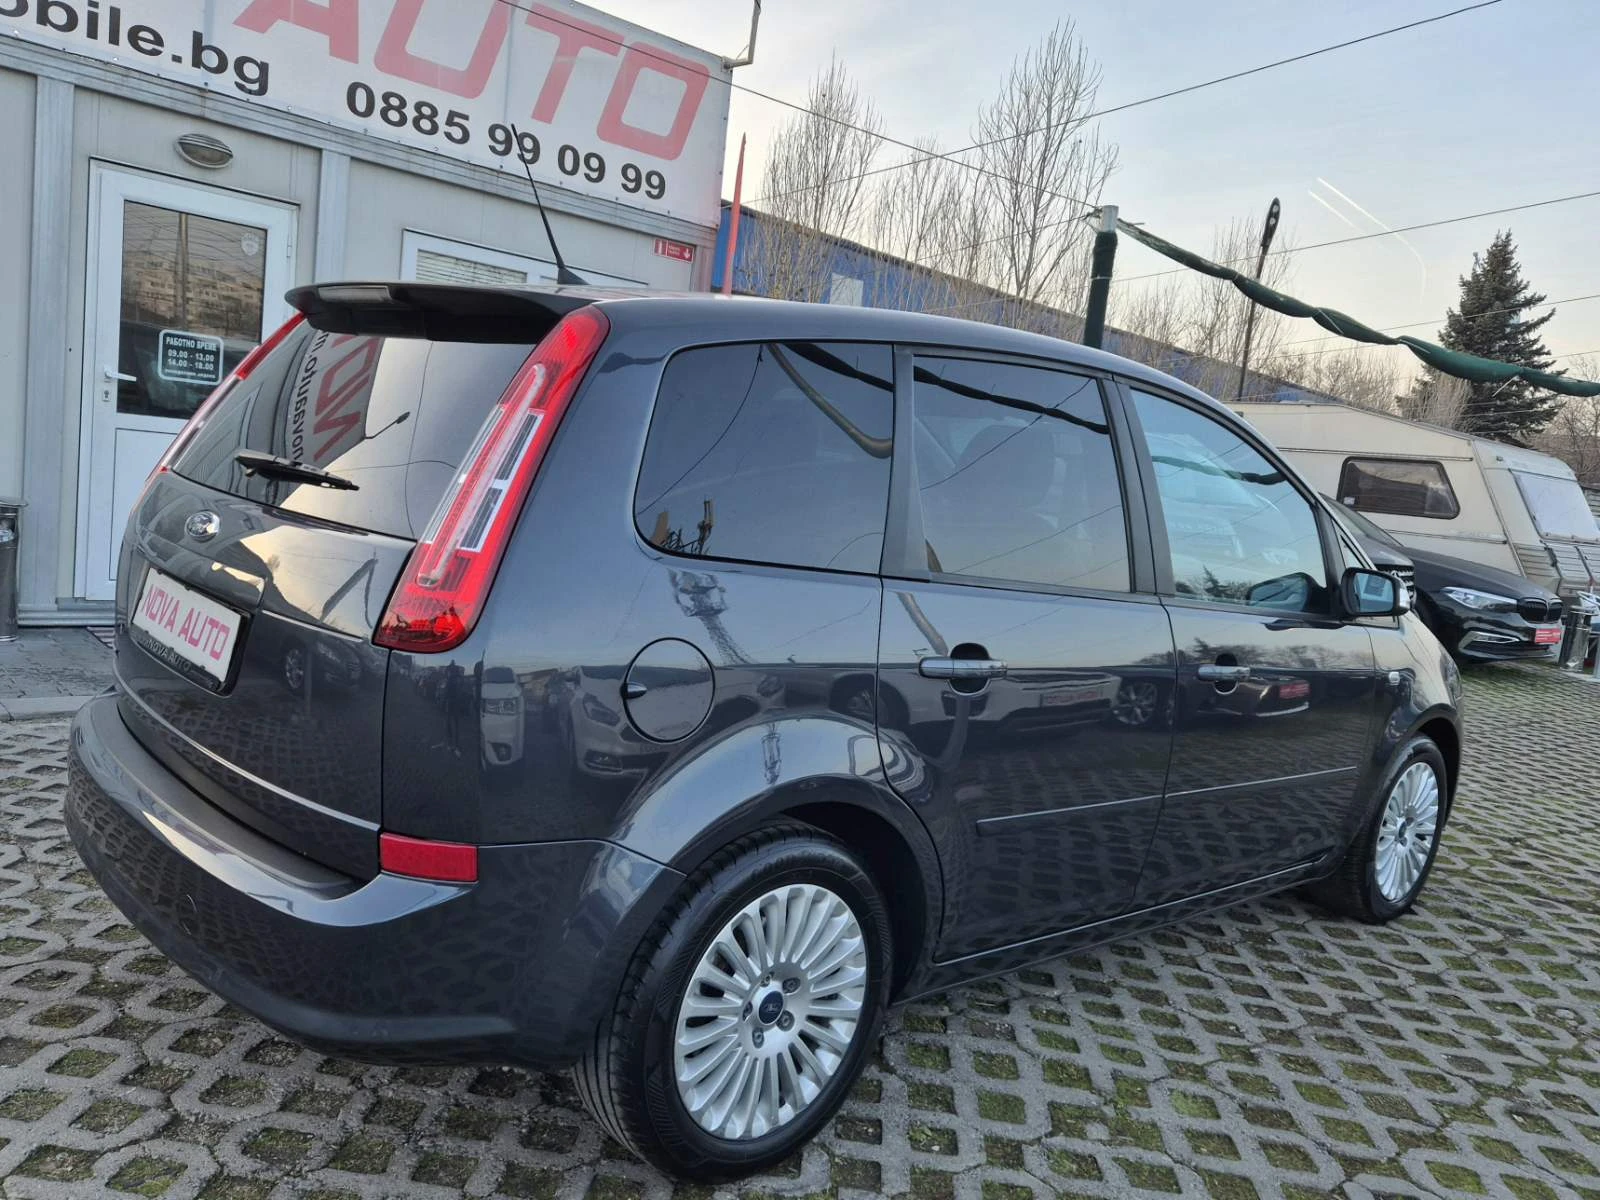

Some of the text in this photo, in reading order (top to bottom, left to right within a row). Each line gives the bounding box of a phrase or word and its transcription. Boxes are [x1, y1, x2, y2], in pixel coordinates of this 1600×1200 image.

[346, 81, 667, 201] 0885 99 09 99
[165, 336, 195, 348] РАБОТНО
[141, 583, 231, 661] NOVA AUTO
